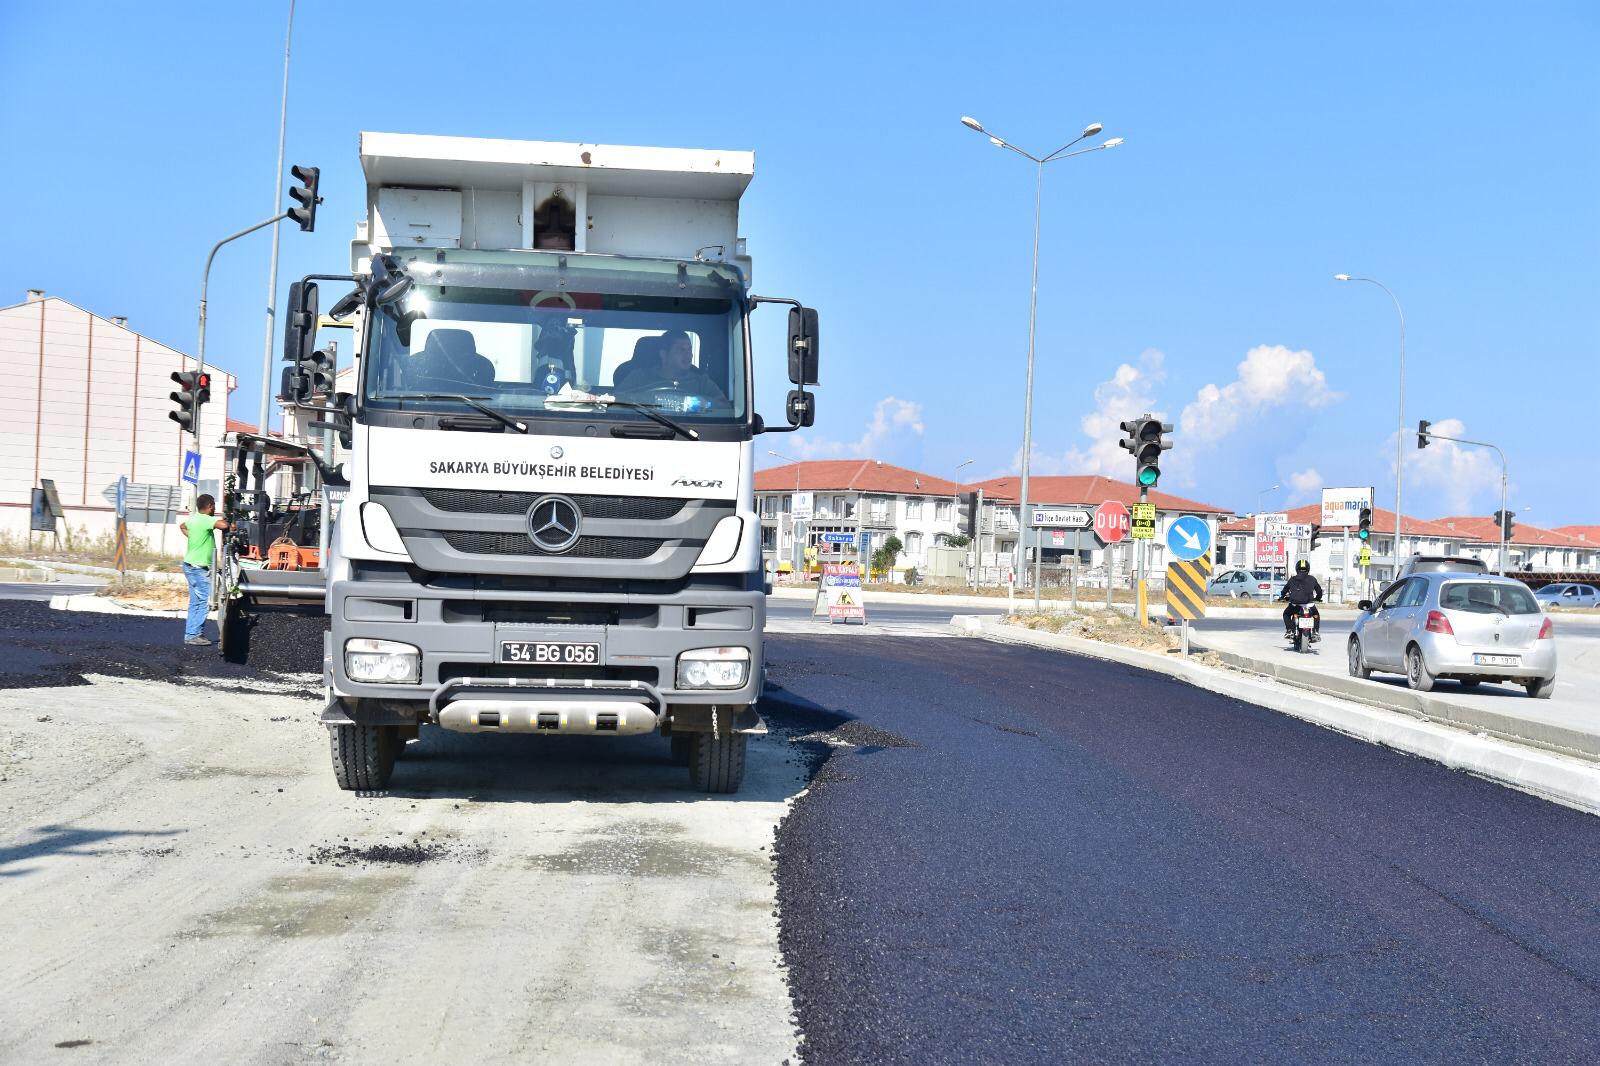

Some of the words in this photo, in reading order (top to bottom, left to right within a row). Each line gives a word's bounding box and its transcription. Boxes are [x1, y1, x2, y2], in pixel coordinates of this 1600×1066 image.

[430, 461, 489, 474] SAKARYA
[493, 460, 577, 480] BÜYÜKŞEHİR
[580, 465, 654, 481] BELEDİYESİ
[1097, 512, 1127, 530] DUR
[511, 644, 530, 661] 54
[536, 645, 560, 662] BG
[565, 645, 595, 662] 056
